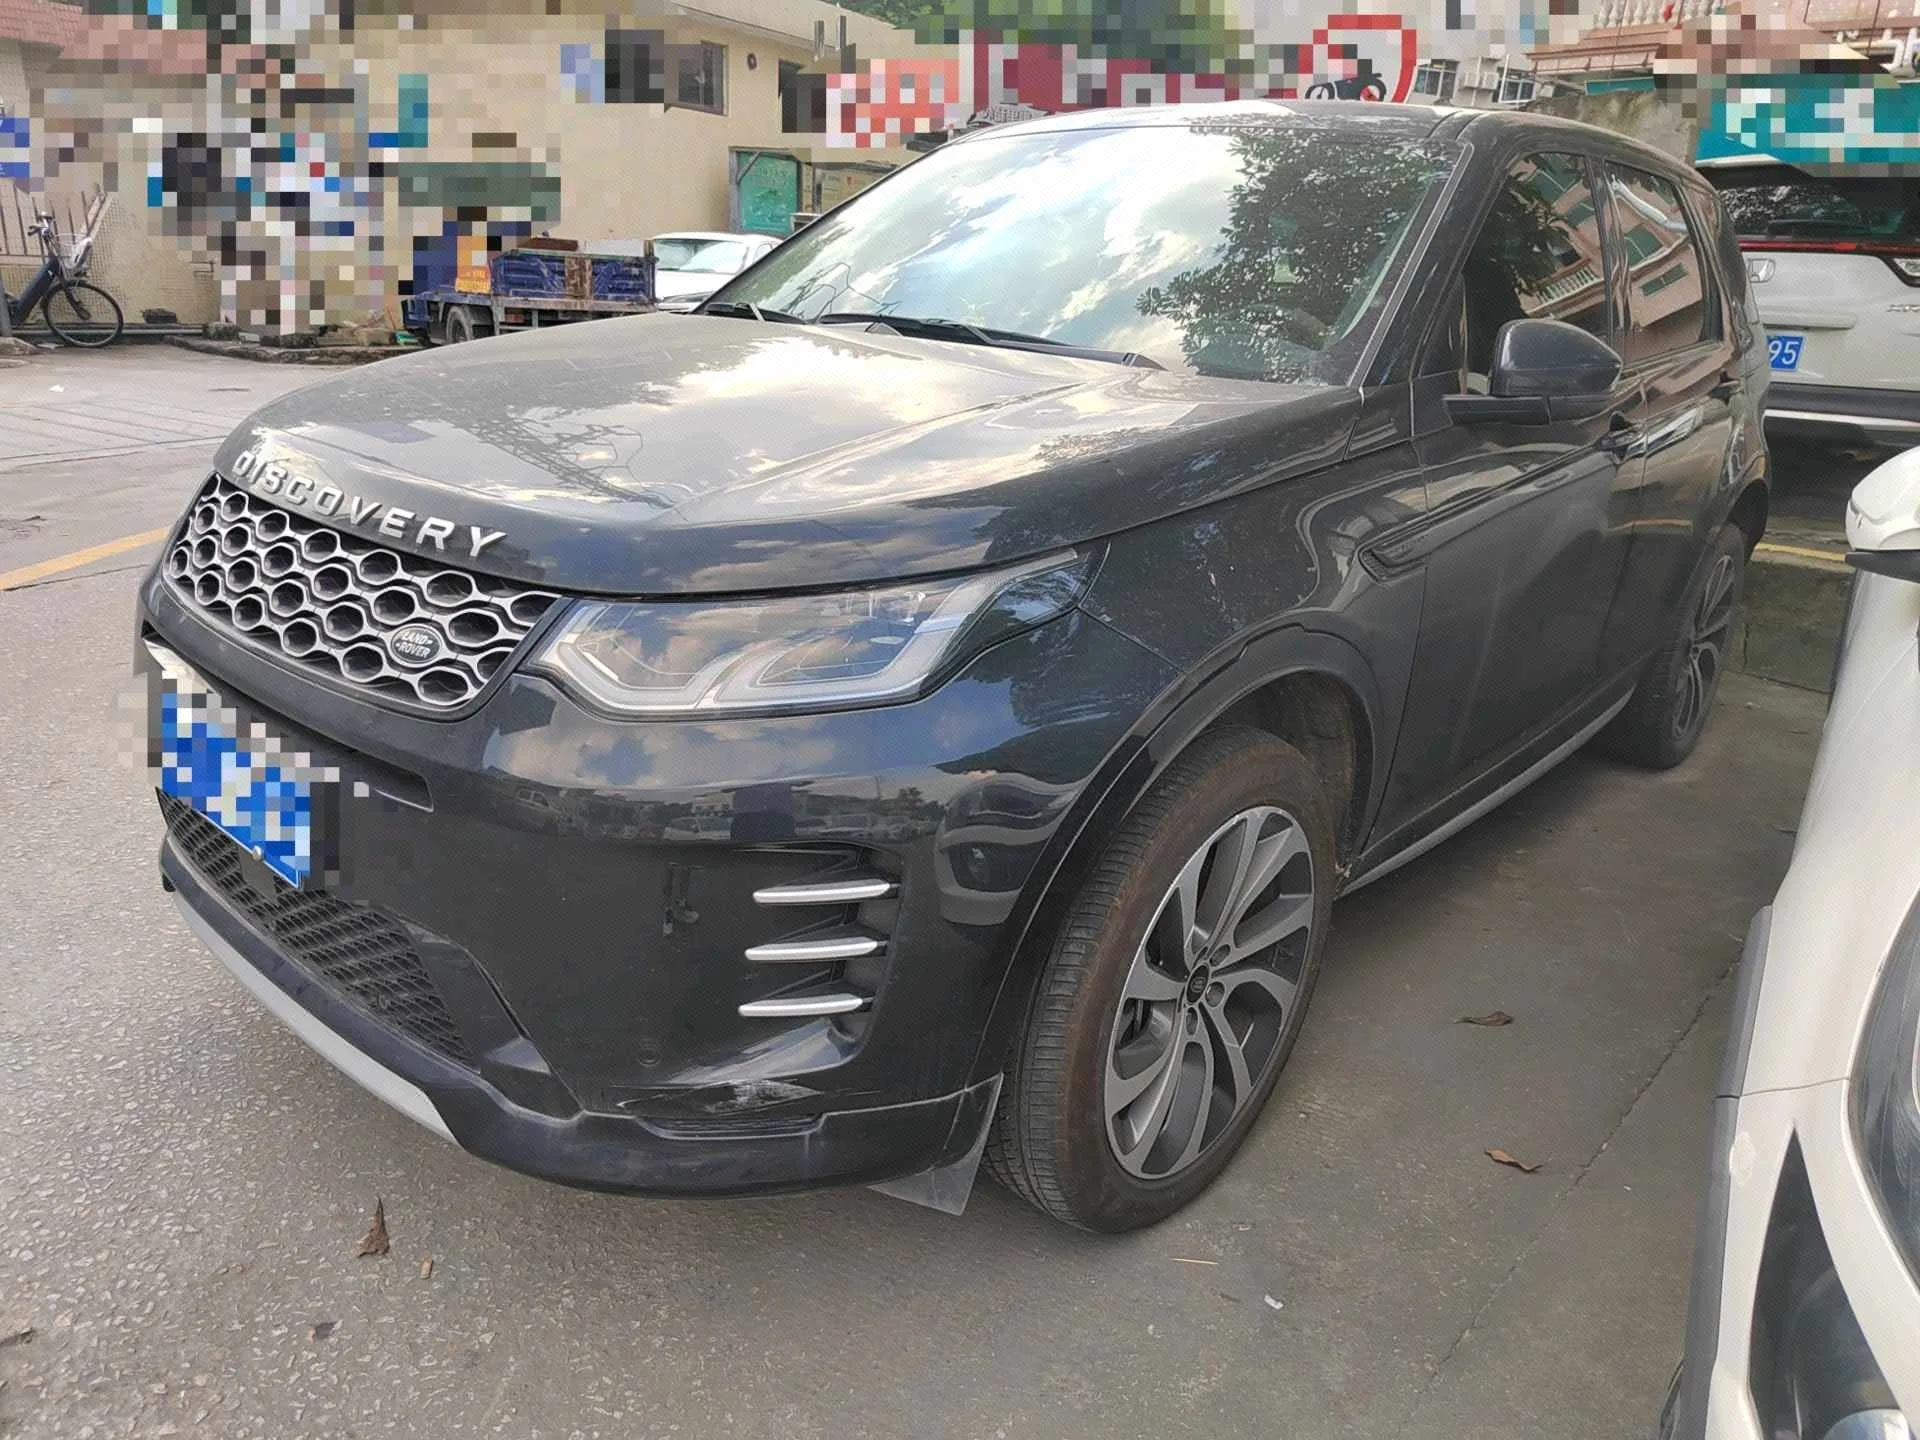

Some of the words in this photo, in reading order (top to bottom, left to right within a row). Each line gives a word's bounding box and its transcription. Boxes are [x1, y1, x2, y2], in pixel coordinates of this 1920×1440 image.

[1768, 340, 1800, 365] 95
[231, 450, 507, 557] DISCOVERY
[398, 641, 431, 658] ROVER
